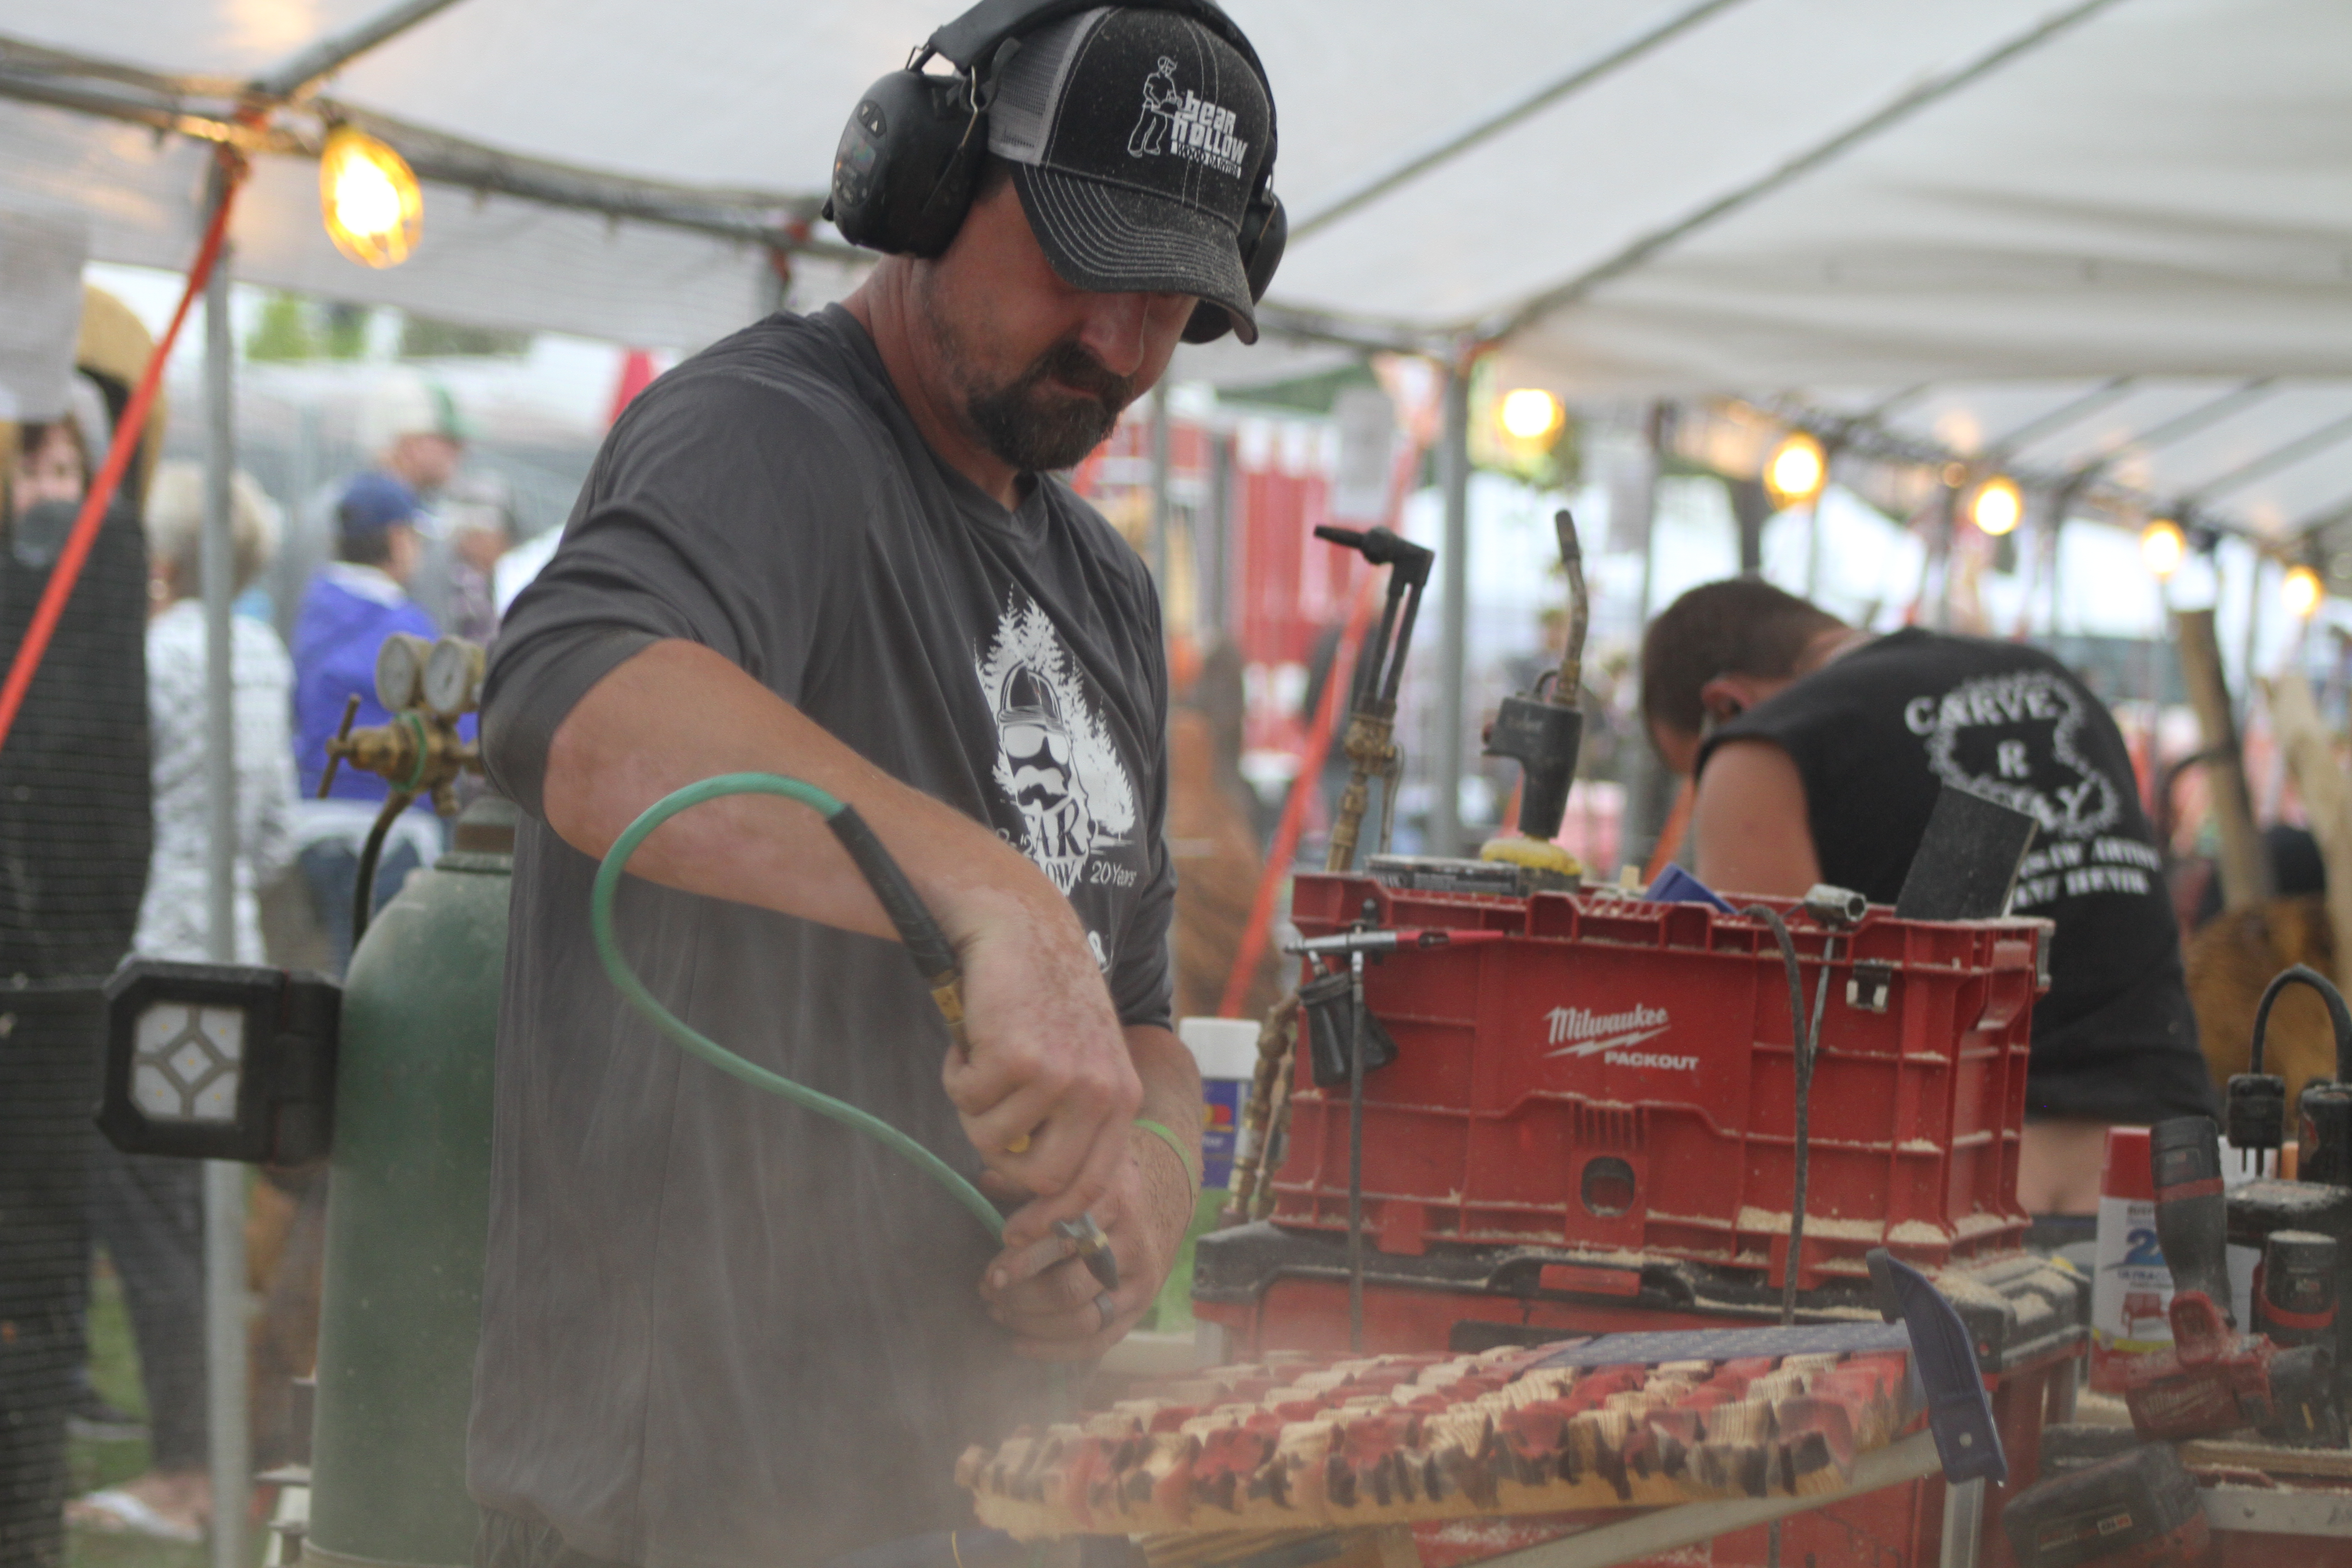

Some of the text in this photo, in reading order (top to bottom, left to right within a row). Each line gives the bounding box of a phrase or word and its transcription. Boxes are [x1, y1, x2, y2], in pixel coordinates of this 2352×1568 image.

[1905, 689, 2057, 735] CARVE
[1998, 739, 2030, 779] R
[1544, 1003, 1669, 1045] Milwaukee
[1604, 1050, 1700, 1072] PACKOUT
